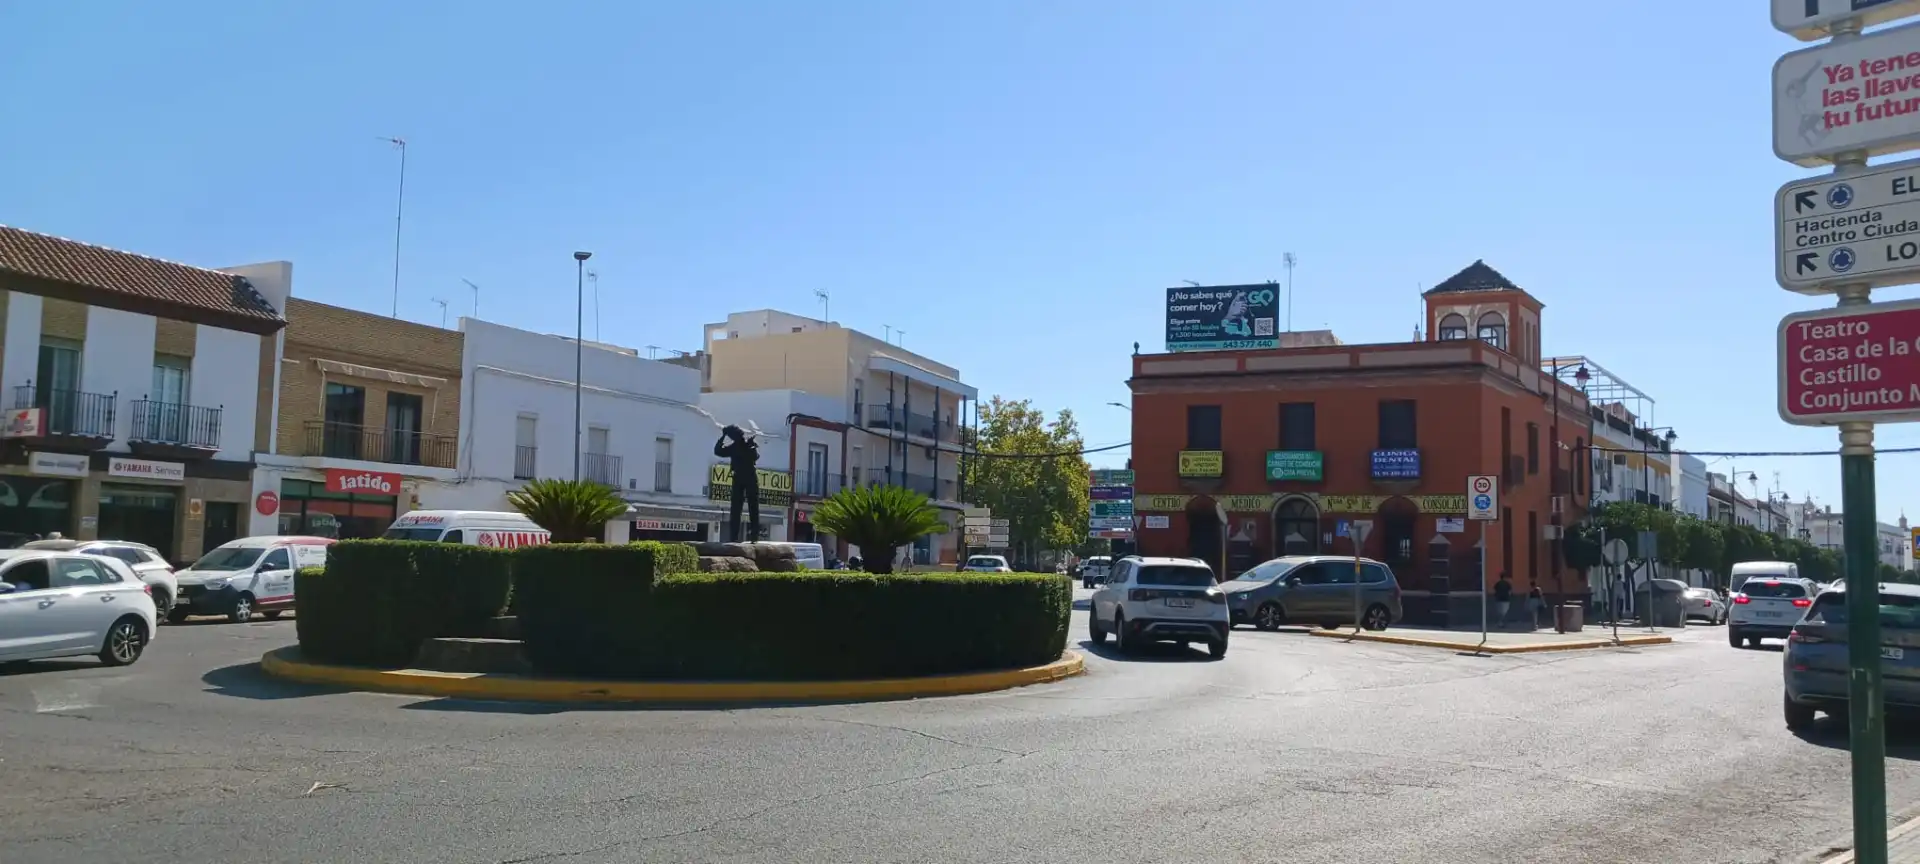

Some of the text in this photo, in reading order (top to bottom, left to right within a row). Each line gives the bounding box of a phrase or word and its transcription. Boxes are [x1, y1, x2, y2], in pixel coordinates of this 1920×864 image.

[1823, 64, 1854, 84] Ya
[1822, 87, 1860, 107] las
[1823, 111, 1851, 129] tu
[1891, 175, 1920, 196] EL
[1795, 211, 1882, 233] Hacienda
[1796, 230, 1856, 247] Centro
[1886, 241, 1920, 262] LO
[1190, 289, 1213, 300] sabes
[1216, 289, 1232, 301] qué
[1170, 304, 1197, 312] comer
[1799, 321, 1870, 340] Teatro
[1800, 344, 1849, 363] Casa
[1855, 339, 1883, 358] de
[1889, 336, 1909, 355] la
[1800, 363, 1881, 385] Castillo
[1800, 387, 1903, 411] Conjunto
[122, 462, 182, 477] YAMAHA Service
[339, 472, 392, 493] latido
[771, 473, 792, 490] QIU
[1153, 498, 1181, 508] CENTRO
[408, 515, 444, 525] YAMAHA
